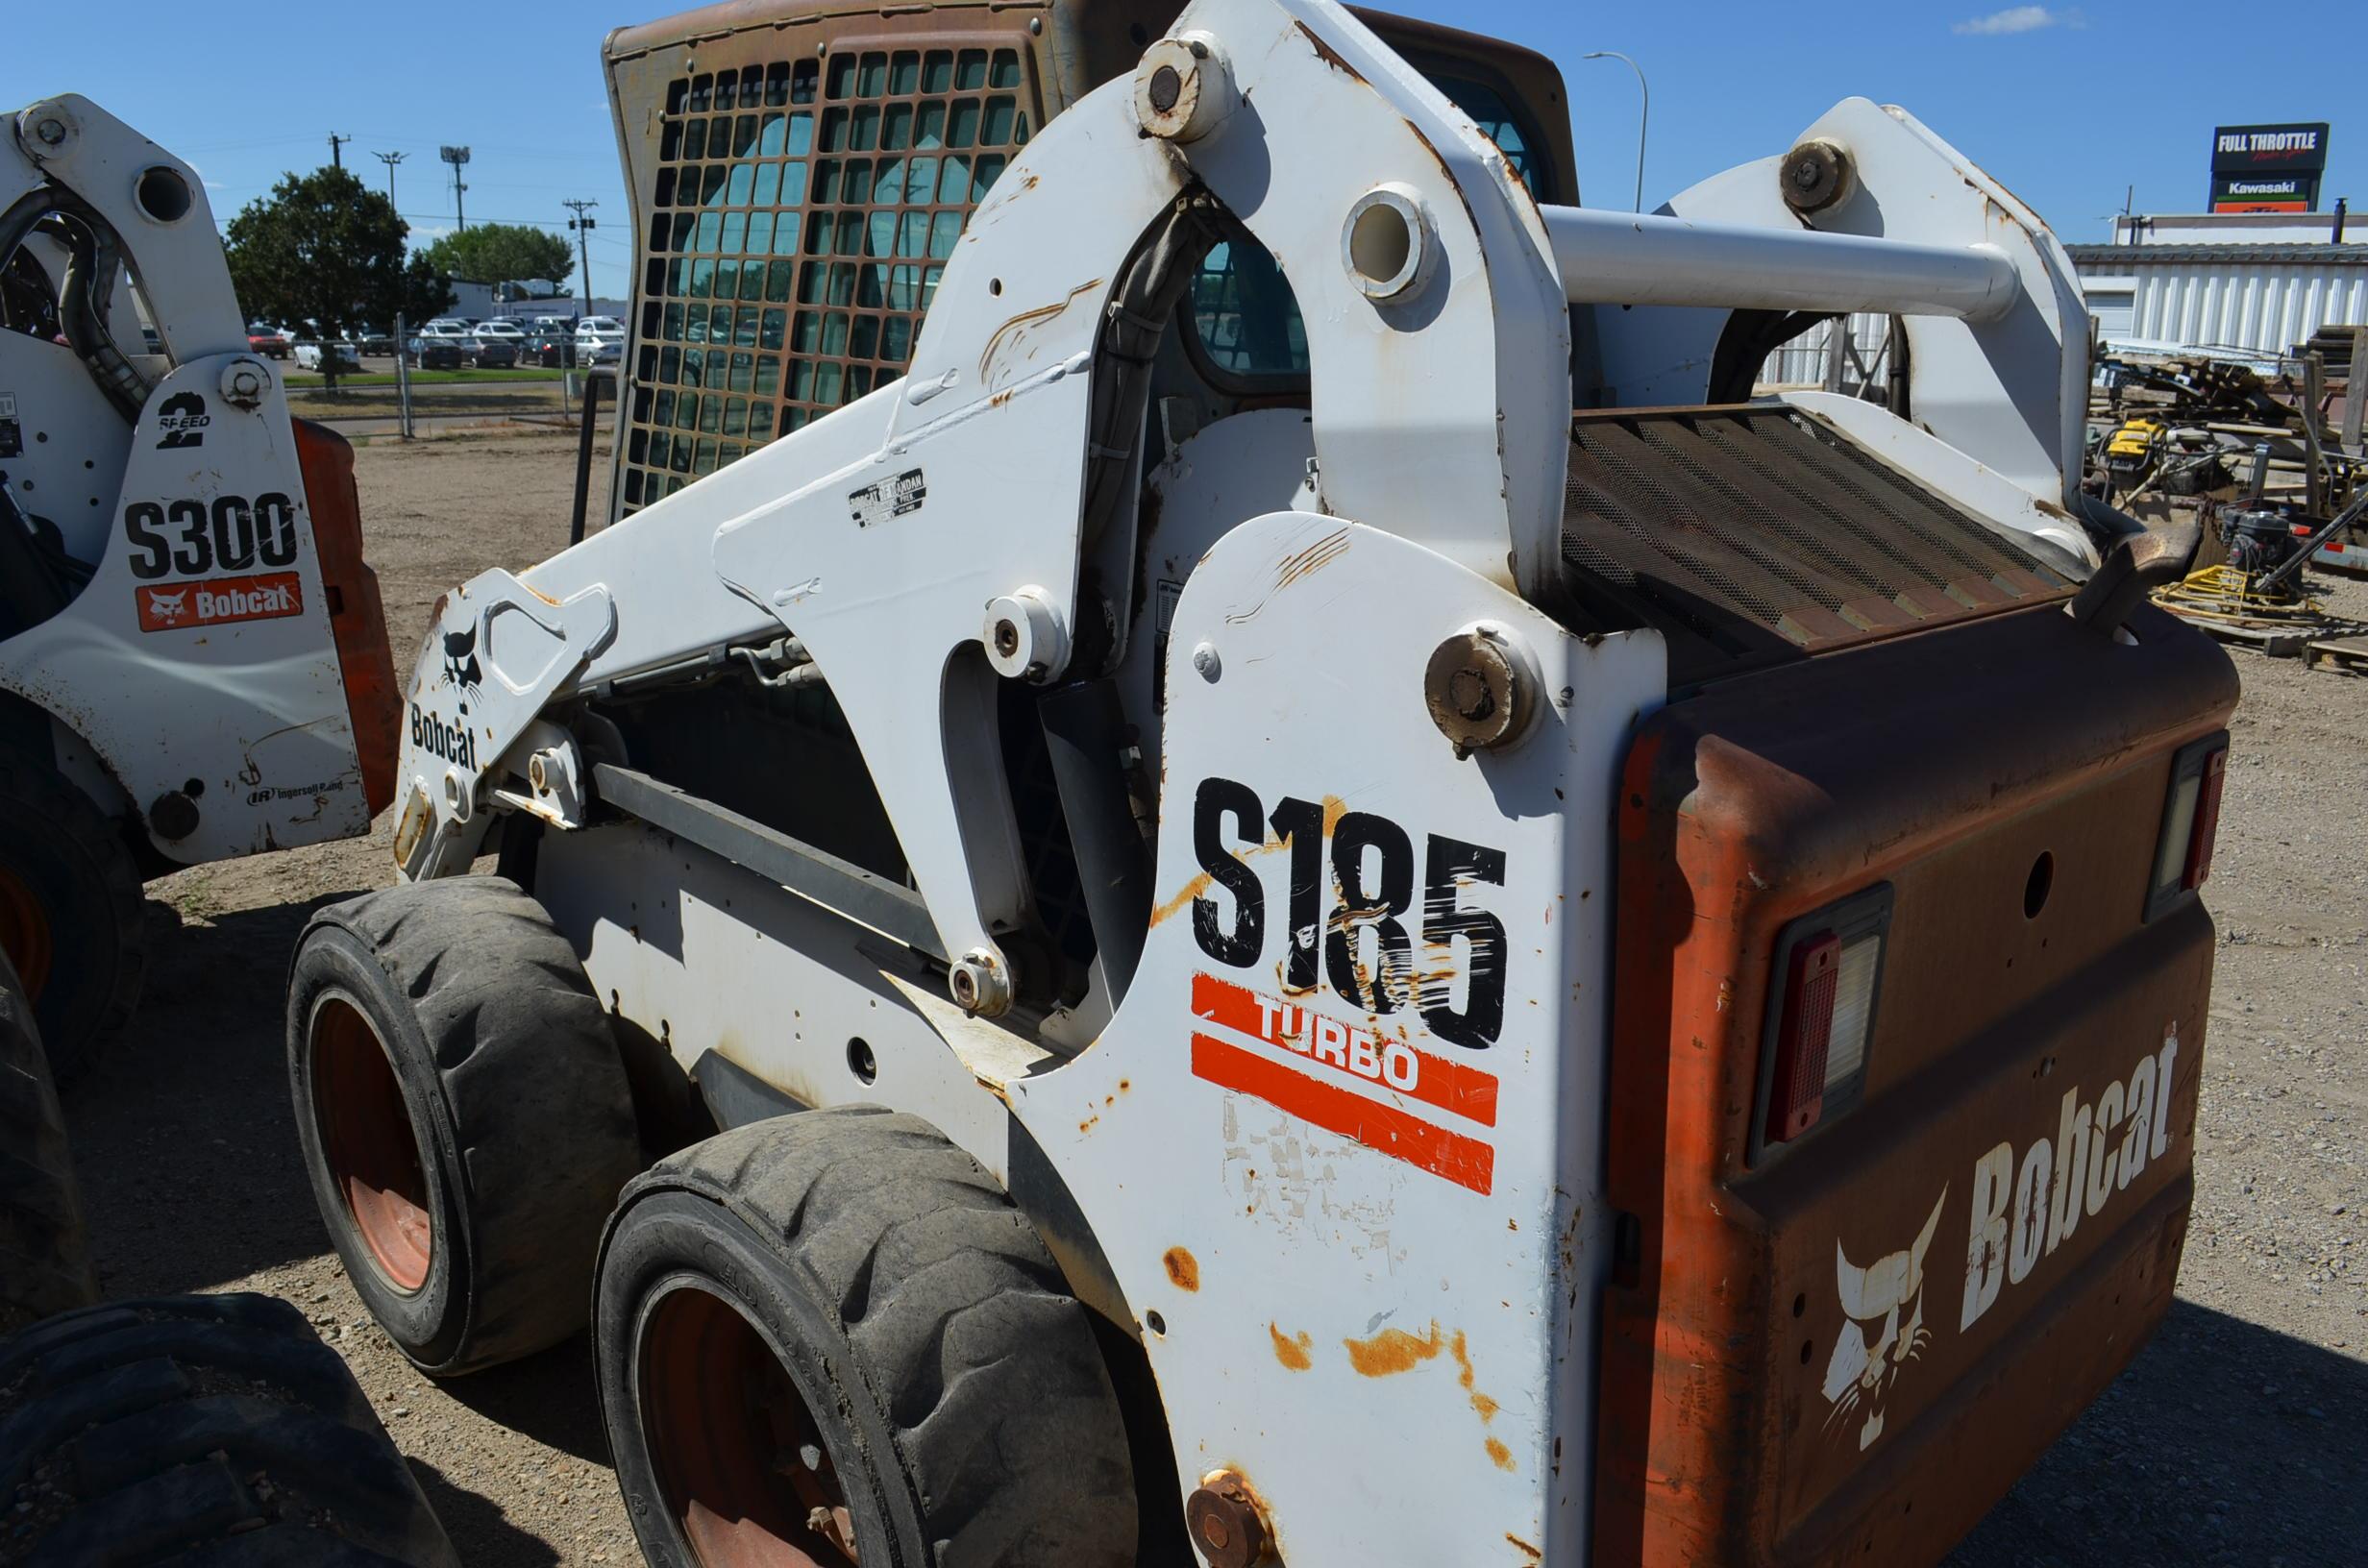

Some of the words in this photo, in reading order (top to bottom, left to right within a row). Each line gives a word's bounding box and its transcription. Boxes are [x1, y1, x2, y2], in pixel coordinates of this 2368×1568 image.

[2218, 135, 2247, 152] FULL
[2250, 132, 2316, 151] THROTTLE
[2229, 182, 2295, 194] Kawasaki
[157, 391, 206, 450] 2
[160, 415, 210, 429] SPEED
[125, 492, 298, 579] S300
[196, 585, 289, 619] Bobcat
[411, 702, 478, 773] Bobcat
[278, 783, 318, 799] Ingersoll
[1192, 776, 1507, 1050] S185
[1253, 996, 1418, 1091] TURBO
[1960, 1020, 2178, 1335] Bobcat
